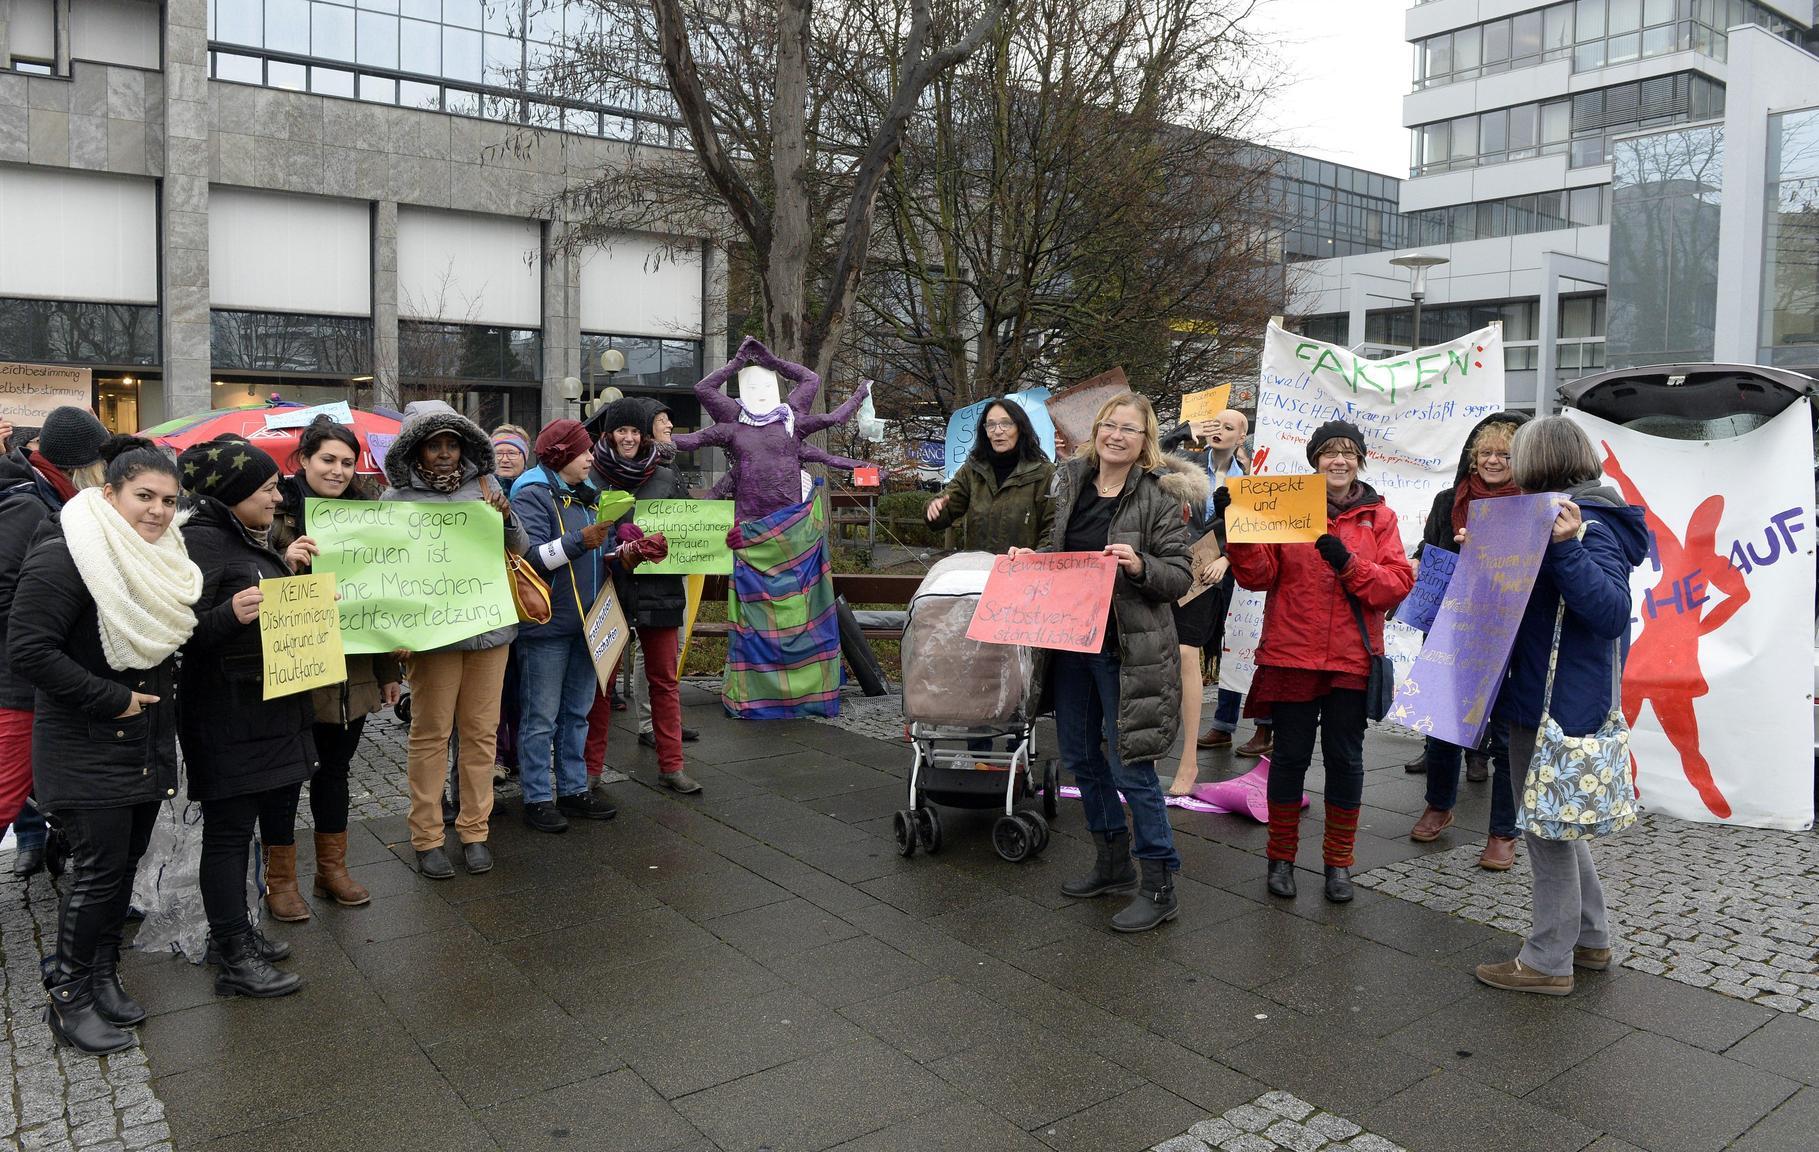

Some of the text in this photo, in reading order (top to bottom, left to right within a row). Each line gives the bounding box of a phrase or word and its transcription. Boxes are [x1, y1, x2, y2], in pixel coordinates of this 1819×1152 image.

[1296, 342, 1483, 404] FAKTEN:
[1240, 478, 1305, 497] Respekt
[647, 501, 700, 518] Gleiche
[1254, 497, 1278, 512] und
[311, 500, 468, 540] Gewalt gegen
[1229, 513, 1312, 533] Achtsamkeit
[333, 537, 452, 565] Frauen ist
[669, 537, 709, 549] Frauen
[1728, 506, 1805, 575] AUF
[669, 551, 715, 565] Mädchen
[1423, 546, 1456, 576] Selb
[280, 580, 319, 603] KEINE
[340, 571, 494, 600] ine Menschen-
[339, 602, 503, 631] echtsverletzung
[273, 630, 314, 658] aufgrund
[268, 657, 326, 686] Hautfarbe
